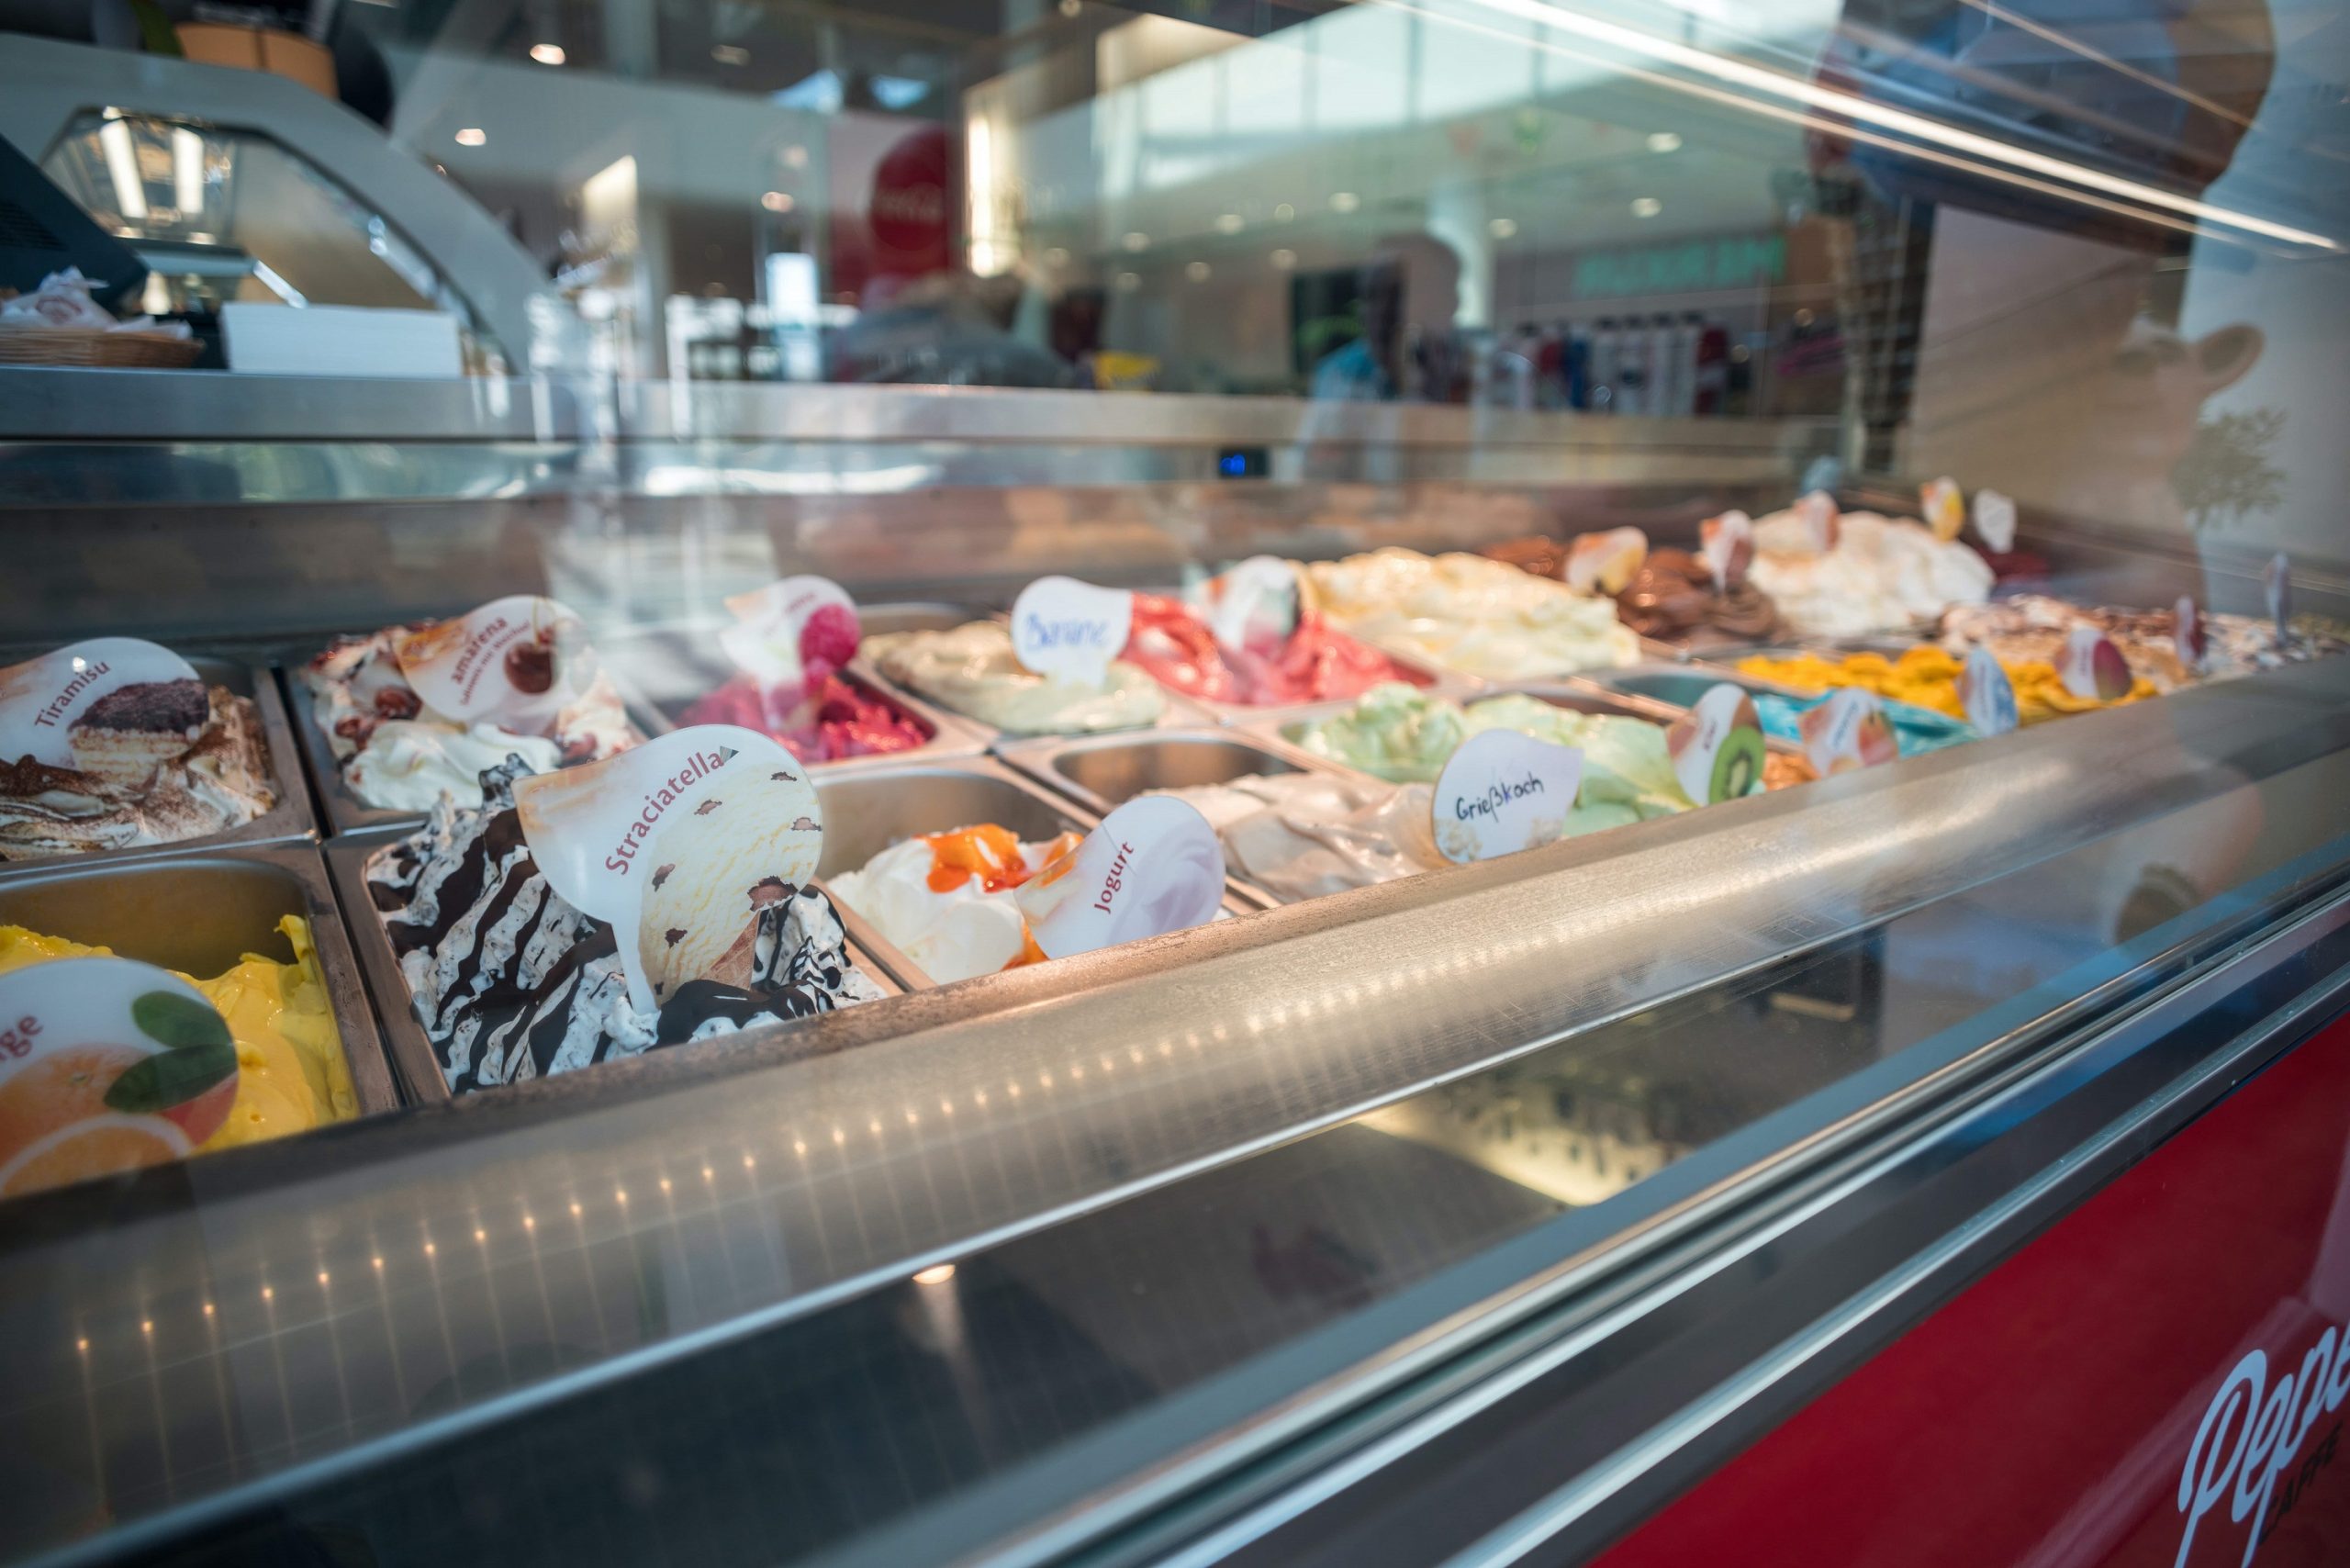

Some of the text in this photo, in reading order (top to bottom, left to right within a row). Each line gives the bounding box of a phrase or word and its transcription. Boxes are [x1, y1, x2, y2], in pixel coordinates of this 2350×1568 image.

[35, 661, 111, 727] Tiramisu
[605, 751, 725, 875] Straciatella
[1093, 841, 1135, 914] Jogurt
